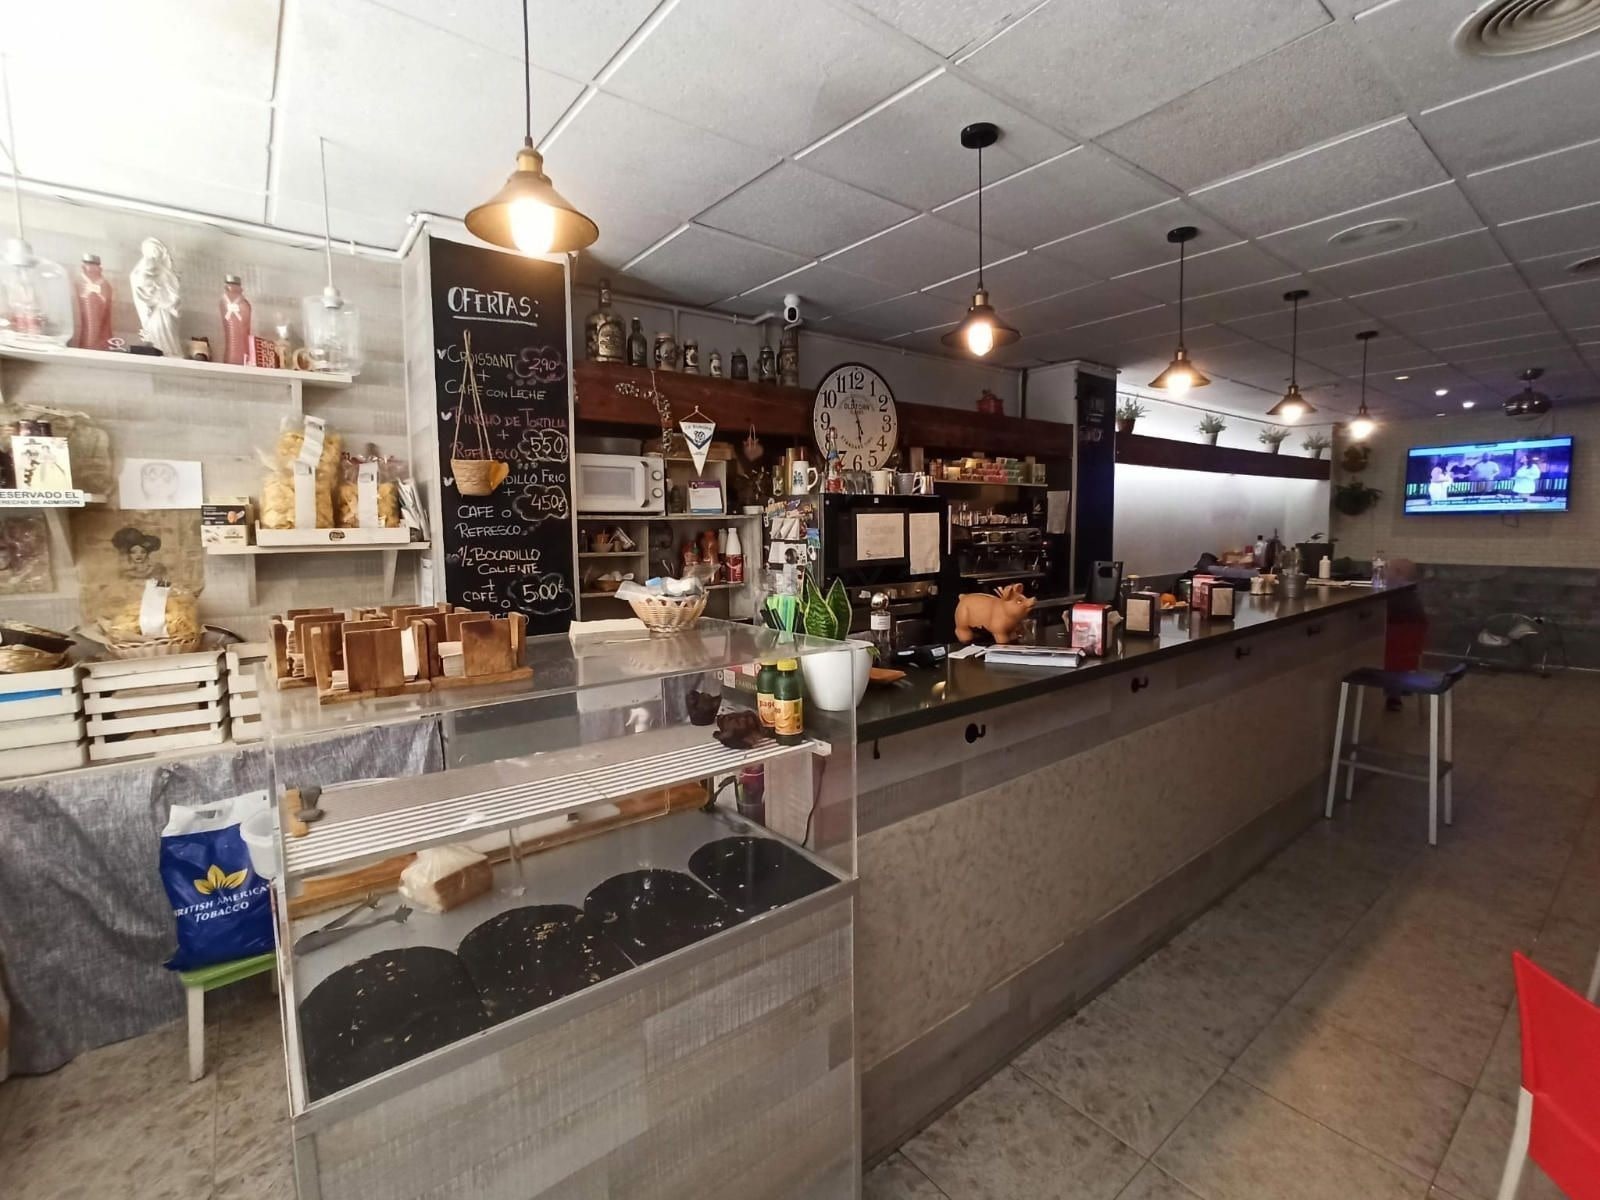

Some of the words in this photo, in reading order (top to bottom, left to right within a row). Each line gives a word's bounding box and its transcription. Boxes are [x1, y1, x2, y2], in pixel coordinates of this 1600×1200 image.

[447, 286, 539, 318] OFERTAS:
[837, 374, 847, 393] 11
[848, 371, 865, 390] 12
[870, 379, 876, 397] 1
[510, 385, 548, 400] LECHE
[820, 390, 837, 409] 10
[878, 395, 888, 412] 2
[505, 416, 522, 427] DE
[820, 412, 831, 430] 9
[882, 415, 891, 433] 3
[876, 435, 888, 452] 4
[852, 455, 862, 471] 6
[868, 450, 878, 467] 5
[65, 491, 79, 499] EL
[470, 547, 541, 561] BOCADILLO
[194, 901, 250, 923] TOBACCO
